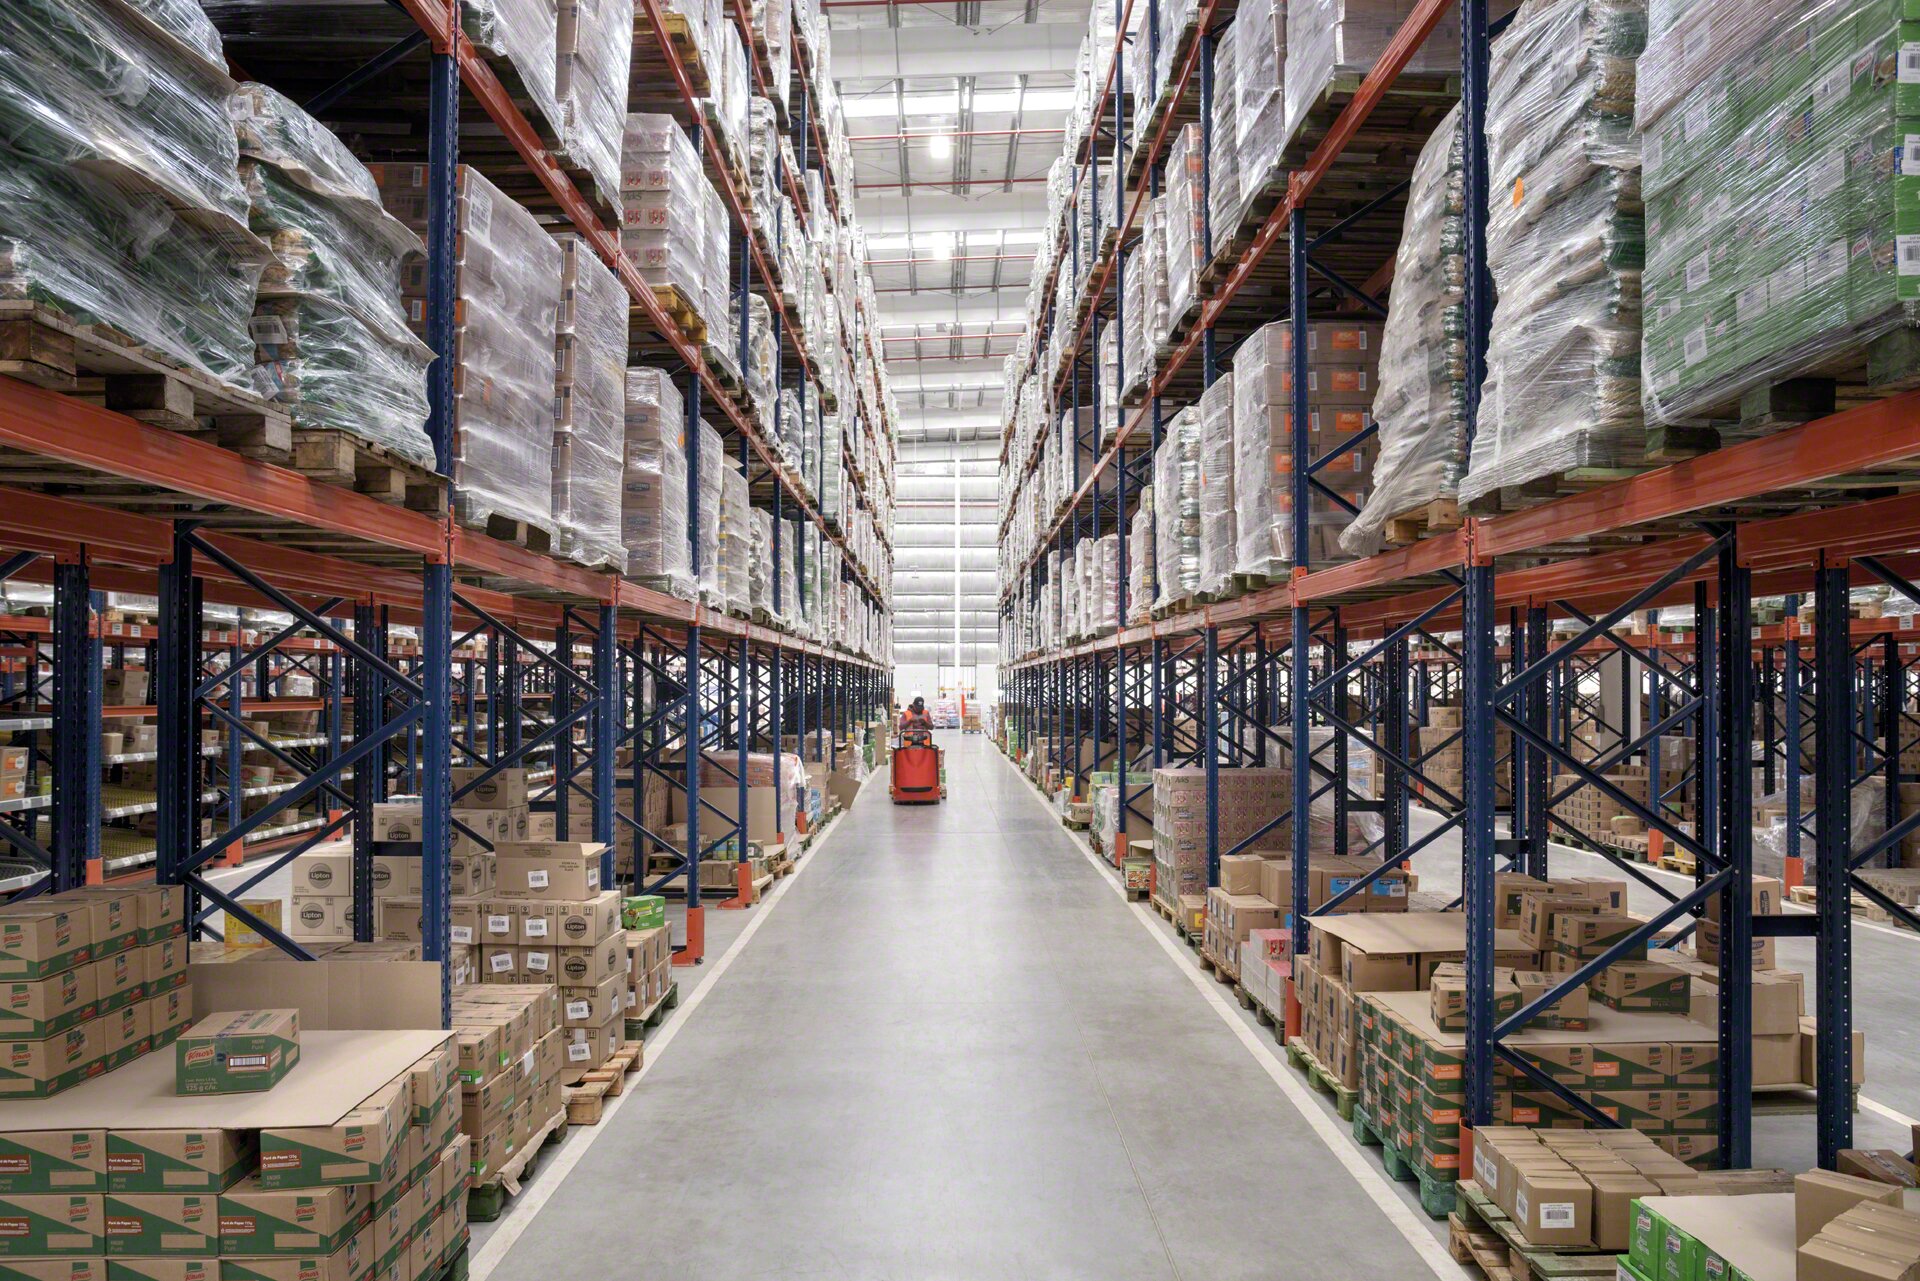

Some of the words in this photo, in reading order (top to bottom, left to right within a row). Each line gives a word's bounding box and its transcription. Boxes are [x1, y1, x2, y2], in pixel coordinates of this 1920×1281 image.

[390, 832, 409, 840] Lipton
[311, 872, 330, 880] Lipton
[303, 911, 322, 919] Lipton
[566, 923, 585, 931] Lipton
[4, 933, 24, 943] Knorr
[10, 994, 30, 1003] Knorr
[1500, 1001, 1514, 1009] Knorr
[9, 1053, 31, 1061] Knorr
[187, 1048, 214, 1061] Knorr
[344, 1136, 366, 1145] Knorr
[72, 1143, 92, 1153] Knorr
[184, 1144, 205, 1153] Knorr
[69, 1207, 90, 1216] Knorr
[182, 1207, 204, 1216] Knorr
[295, 1207, 317, 1216] Knorr
[1638, 1218, 1650, 1228] Knorr
[1707, 1258, 1723, 1271] Knorr
[71, 1272, 92, 1281] Knorr
[185, 1272, 205, 1281] Knorr
[299, 1271, 319, 1280] Knorr
